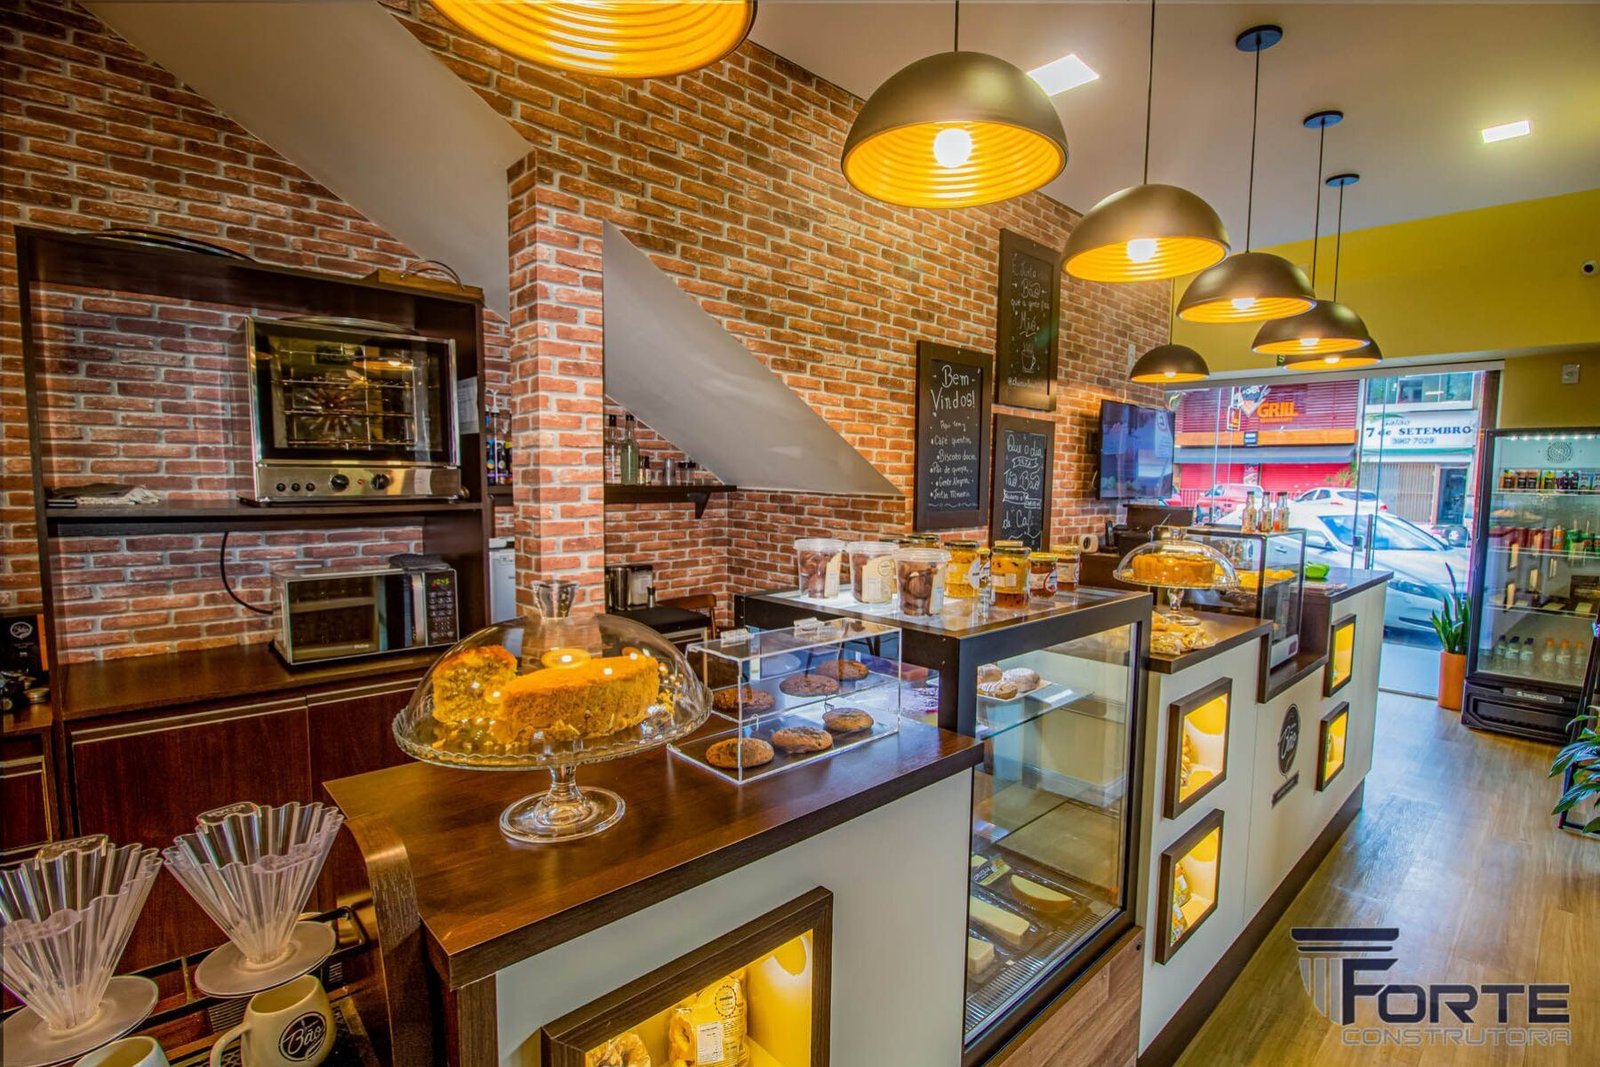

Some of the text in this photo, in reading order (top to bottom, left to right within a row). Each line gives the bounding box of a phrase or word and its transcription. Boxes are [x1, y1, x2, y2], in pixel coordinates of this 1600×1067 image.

[941, 364, 970, 388] Bem
[930, 388, 976, 412] Vindos!
[1256, 401, 1299, 418] GRILL
[1365, 427, 1376, 438] 7
[1398, 425, 1473, 436] SETEMBRO
[944, 464, 951, 474] de
[284, 1025, 322, 1055] Bão
